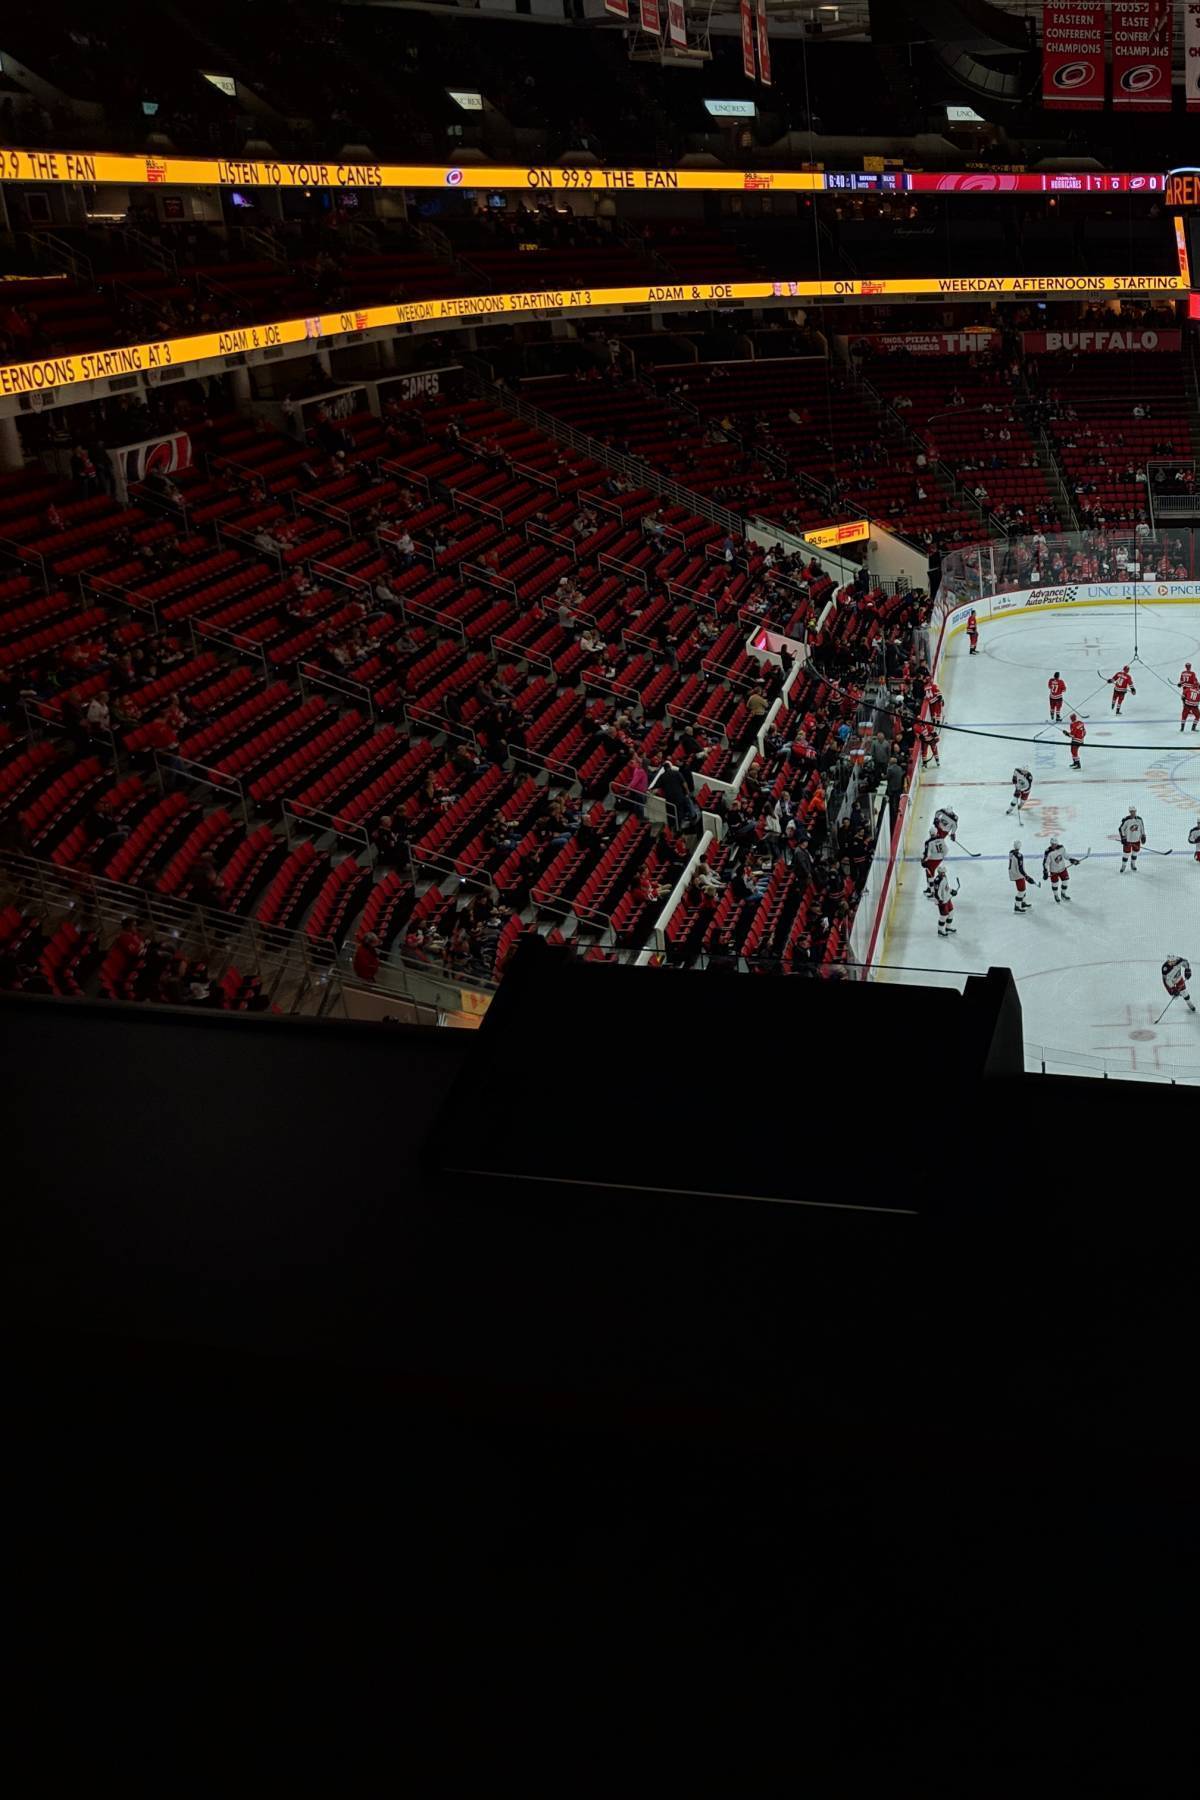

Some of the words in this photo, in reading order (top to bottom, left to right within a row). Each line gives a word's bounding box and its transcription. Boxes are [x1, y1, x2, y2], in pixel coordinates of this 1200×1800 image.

[1053, 15, 1094, 25] EASTERN
[1046, 29, 1101, 39] CONFERENCE
[1046, 43, 1101, 54] CHAMPIONS
[28, 154, 59, 179] THE
[67, 156, 97, 180] FAN
[217, 162, 260, 186] LISTEN
[265, 164, 282, 186] TO
[287, 164, 329, 187] YOUR
[336, 164, 383, 187] CANES
[527, 169, 553, 189] ON
[561, 171, 593, 189] 99.9
[602, 171, 635, 188] THE
[645, 171, 678, 189] FAN
[1149, 177, 1157, 189] 0
[834, 281, 854, 294] ON
[938, 278, 1004, 292] WEEKDAY
[1012, 277, 1106, 291] AFTERNOONS
[1113, 277, 1179, 290] STARTING
[648, 286, 684, 301] ADAM
[692, 286, 701, 299] &
[708, 285, 732, 299] JOE
[395, 303, 435, 322] WEEKDAY
[440, 295, 506, 316] AFTERNOONS
[509, 291, 563, 310] STARTING
[570, 291, 583, 305] AT
[584, 290, 592, 304] 3
[340, 314, 353, 332] ON
[218, 328, 249, 354] ADAM
[252, 328, 260, 347] &
[264, 325, 281, 347] JOE
[905, 336, 931, 344] PIZZA
[942, 334, 992, 352] THE
[1046, 331, 1158, 351] BUFFALO
[80, 349, 142, 380] STARTING
[149, 346, 161, 367] AT
[162, 347, 172, 364] 3
[837, 524, 865, 540] ESPN
[1029, 587, 1065, 600] Advance
[1087, 586, 1119, 598] UNC
[1123, 585, 1151, 597] REX
[1024, 597, 1042, 607] Auto
